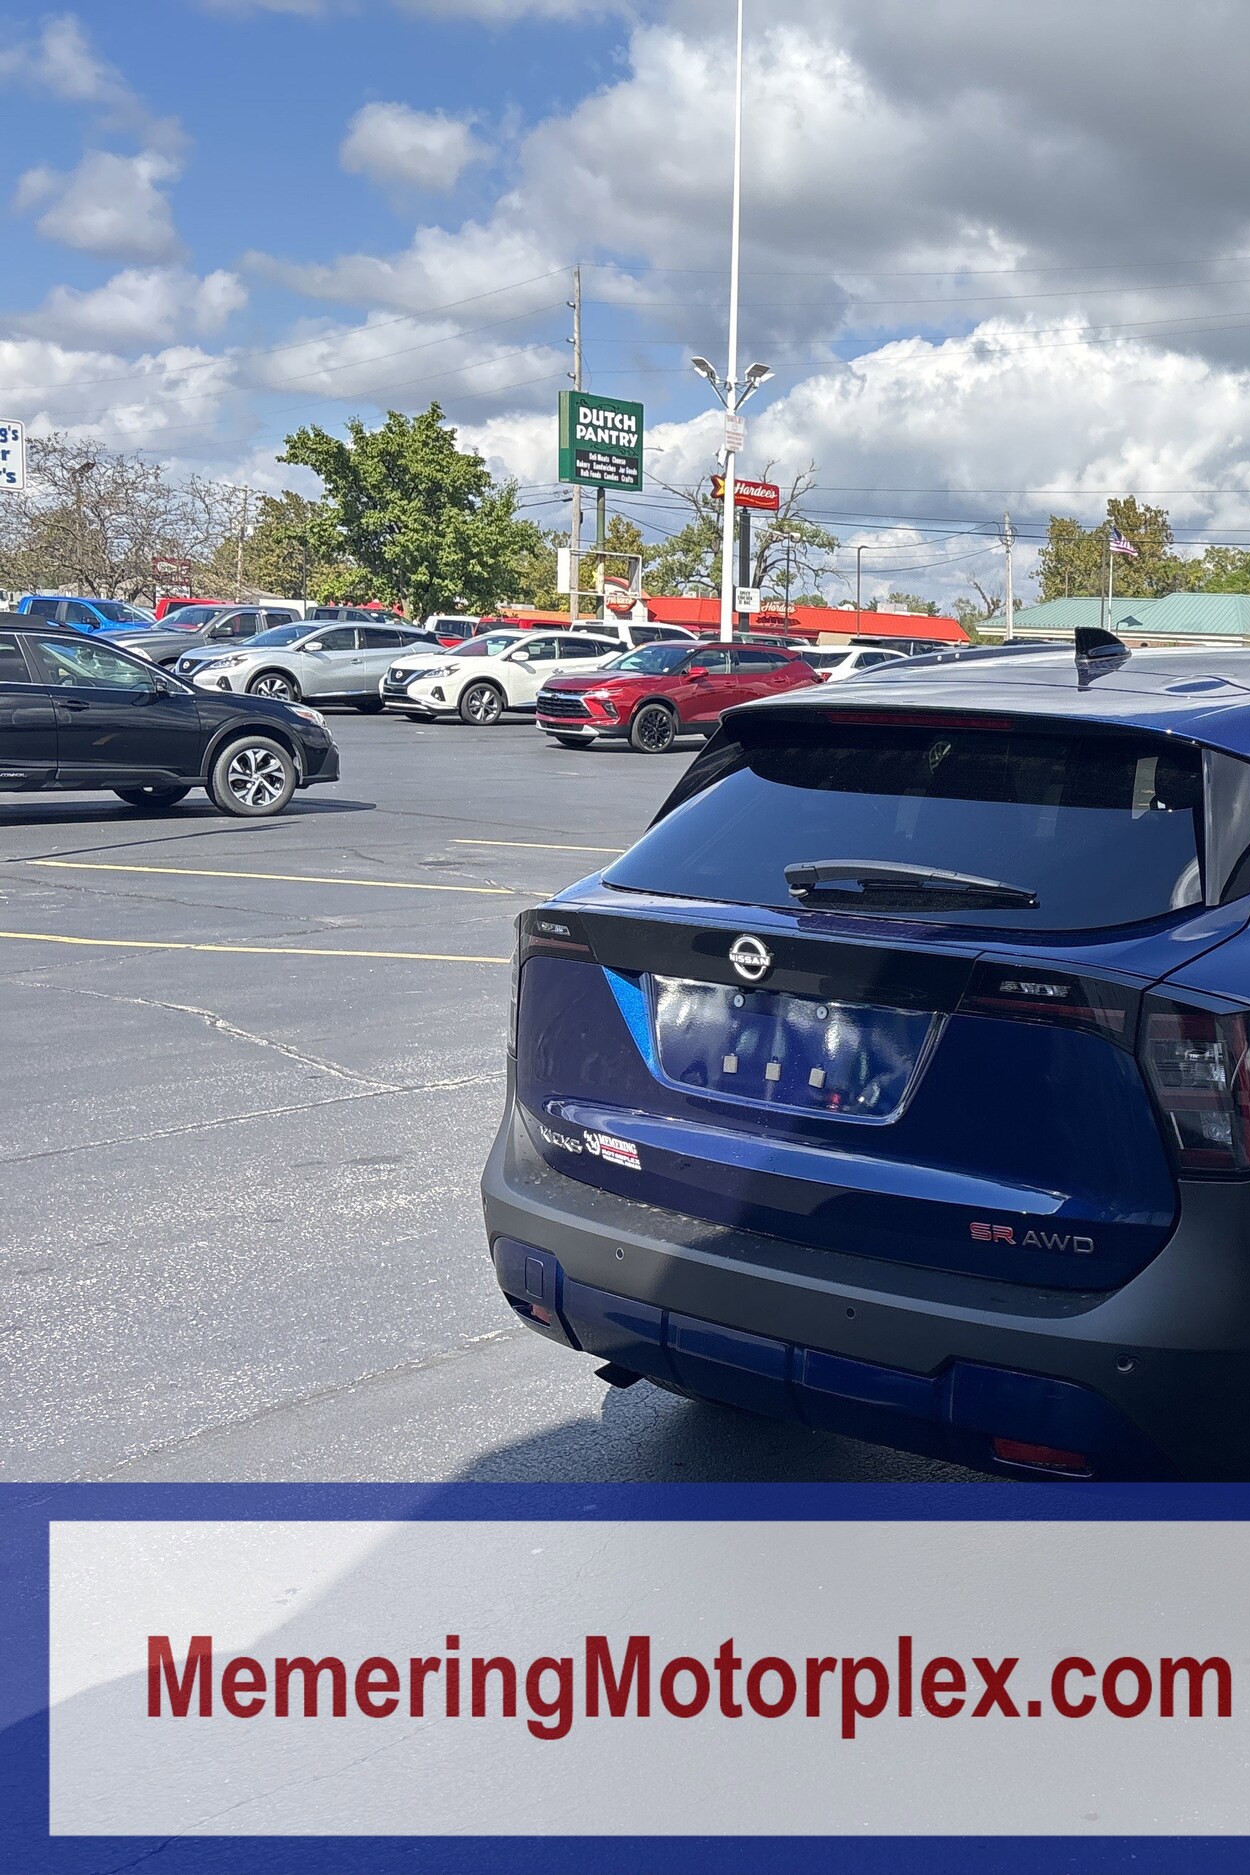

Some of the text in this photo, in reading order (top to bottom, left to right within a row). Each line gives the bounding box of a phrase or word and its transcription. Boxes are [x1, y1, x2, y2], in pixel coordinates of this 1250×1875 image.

[579, 406, 636, 431] DUTCH
[576, 425, 638, 447] PANTRY
[576, 459, 591, 469] Bakery
[593, 462, 616, 472] Sandwiches
[621, 474, 634, 484] Crafts
[734, 482, 777, 499] Hardee's
[729, 953, 770, 966] NISSAN
[540, 1125, 583, 1154] KICKS
[598, 1133, 638, 1154] MEMERING
[969, 1222, 1094, 1254] SR AWD
